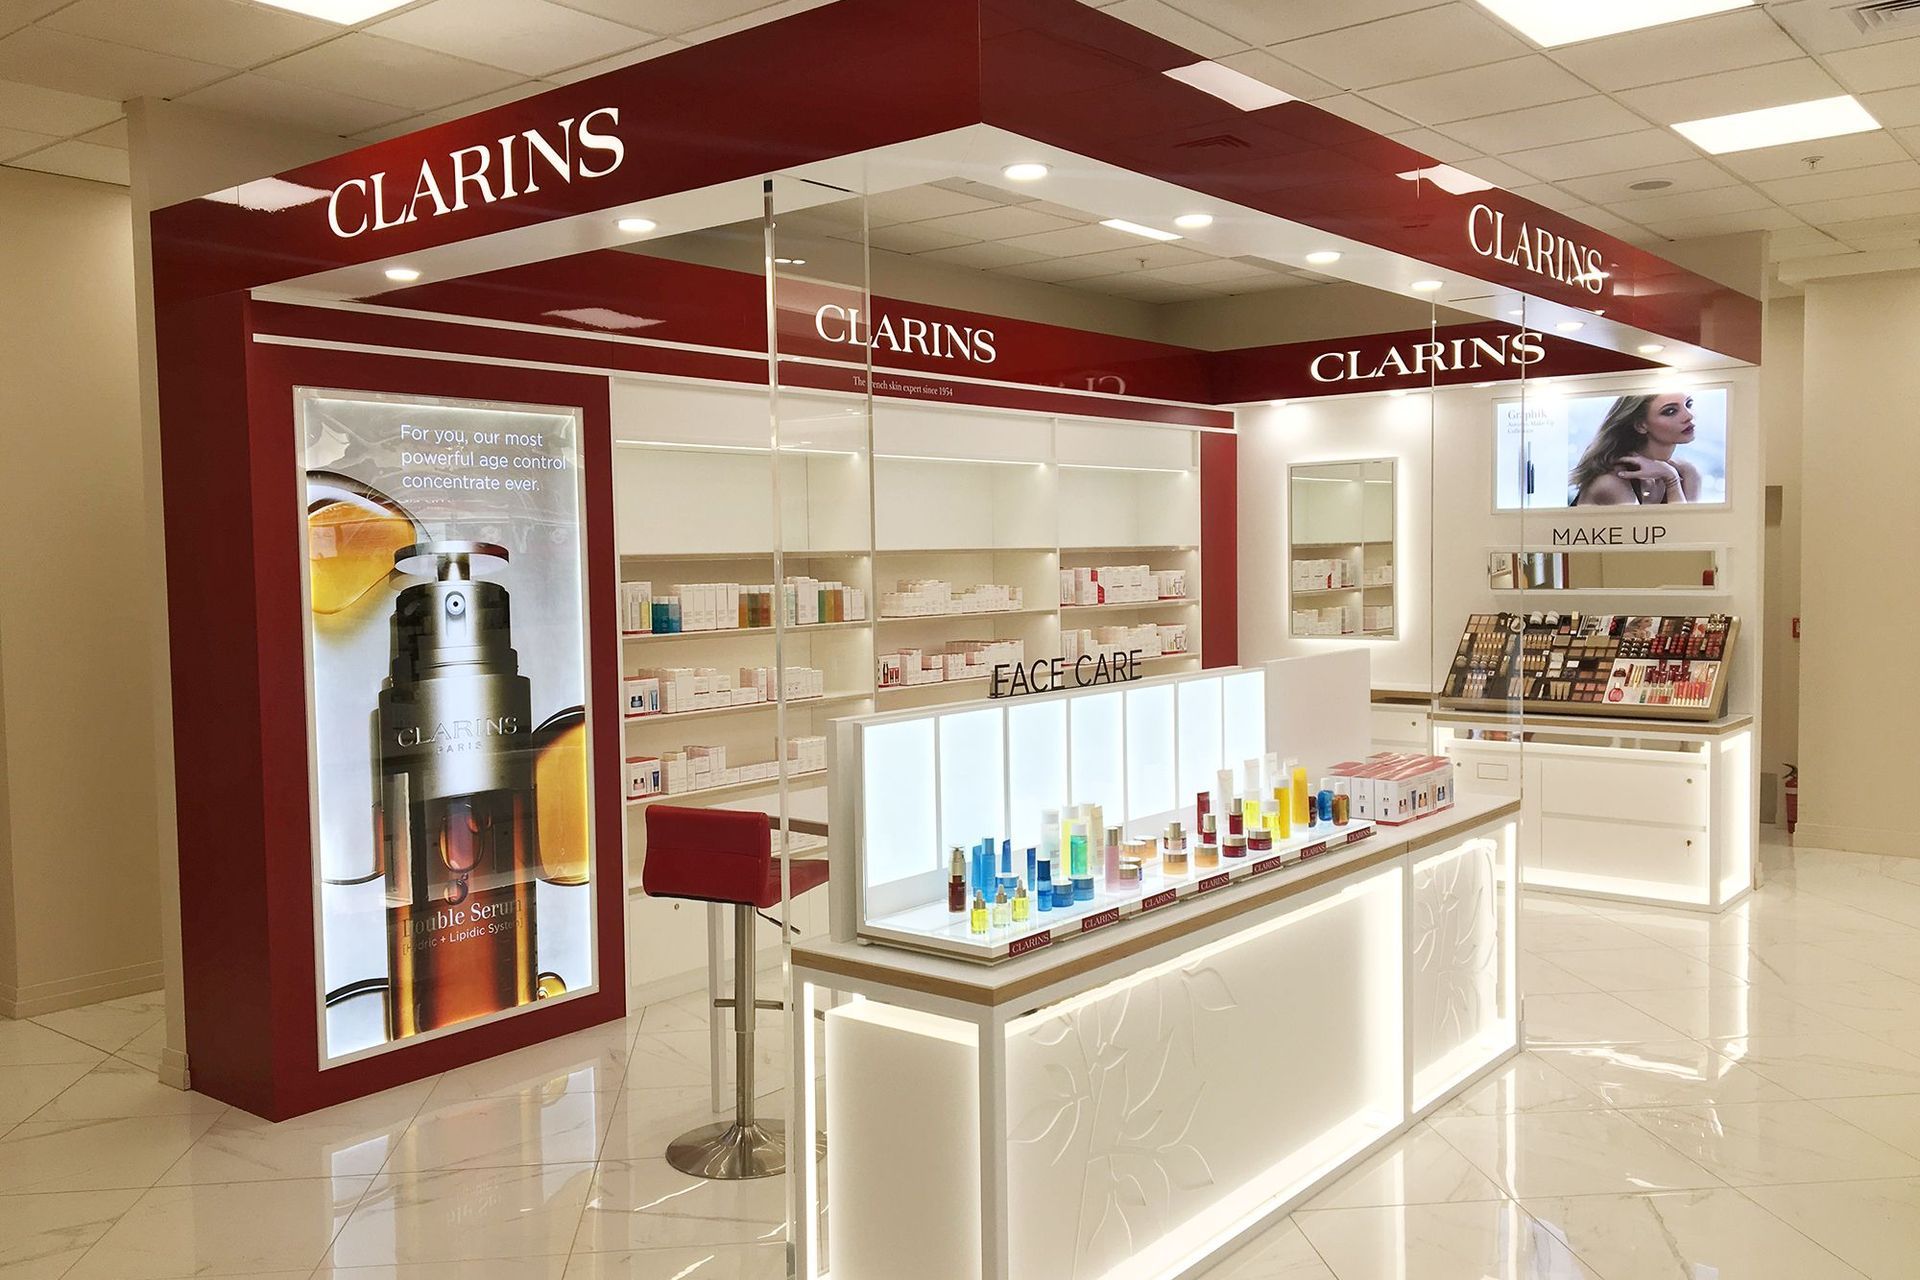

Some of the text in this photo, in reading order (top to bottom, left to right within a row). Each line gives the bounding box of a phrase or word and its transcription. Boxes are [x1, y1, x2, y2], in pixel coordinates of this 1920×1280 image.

[327, 107, 625, 238] CLARINS
[1468, 203, 1604, 295] CLARINS
[815, 304, 997, 363] CLARINS
[1310, 332, 1547, 383] CLARINS
[853, 376, 953, 397] The ench skin expert since 1954
[1508, 408, 1547, 421] Grphik
[401, 424, 543, 447] For you, our most
[401, 451, 567, 470] powerful age control
[402, 475, 540, 491] concentrate ever.
[1553, 526, 1667, 545] MAKE UP
[994, 649, 1143, 698] FACE CARE
[398, 716, 518, 748] CLARINS
[437, 741, 482, 755] PARIS
[1200, 874, 1229, 891] CLARINS
[1144, 890, 1176, 909] CLARINS
[1084, 911, 1119, 930] CLARINS
[449, 925, 486, 943] Lipidic
[1011, 933, 1050, 954] CLARINS
